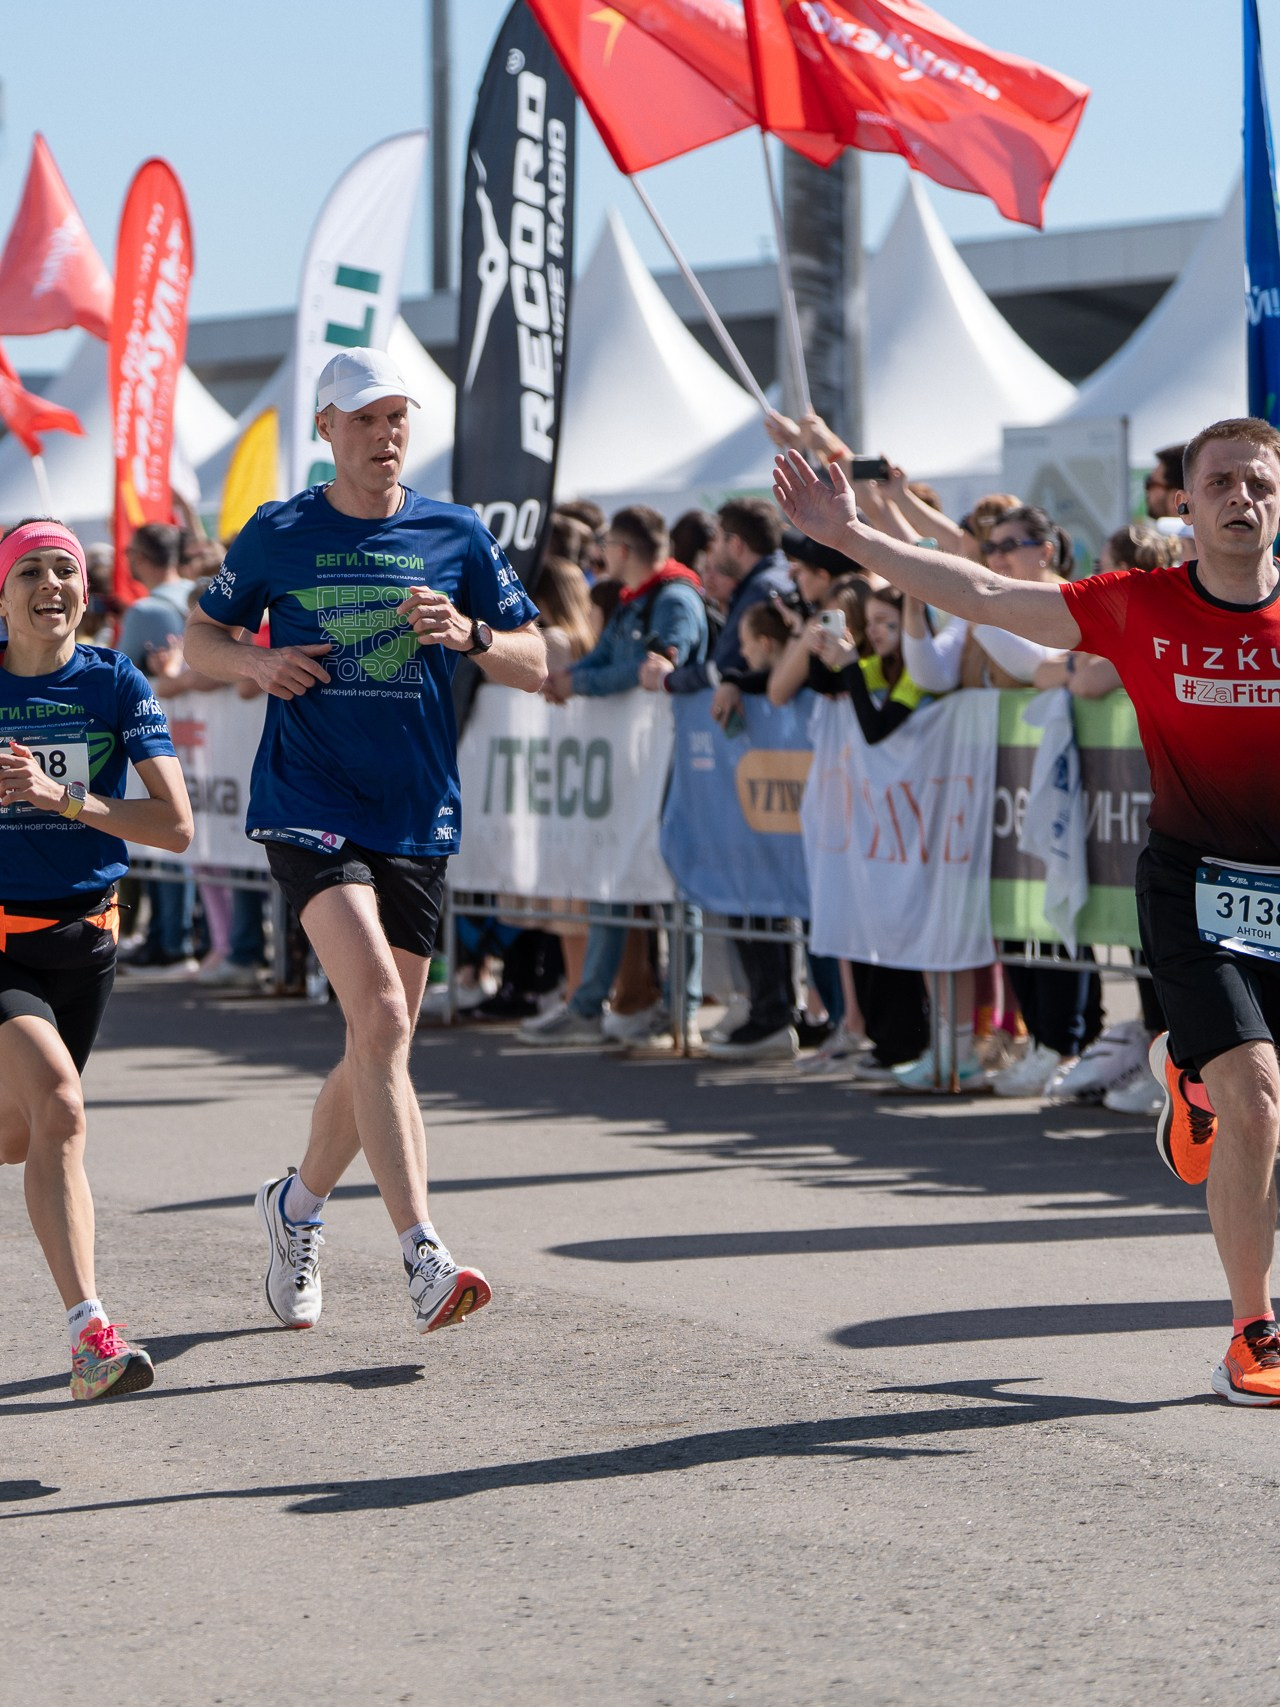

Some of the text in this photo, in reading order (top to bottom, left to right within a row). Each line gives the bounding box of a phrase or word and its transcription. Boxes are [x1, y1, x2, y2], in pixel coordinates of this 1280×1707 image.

[546, 118, 568, 258] RADIO
[509, 69, 556, 464] RECORD
[316, 553, 425, 570] БЕГИ, ГЕРОЙ!
[320, 628, 420, 660] ЭТОТ
[321, 657, 424, 685] ГОРОД
[321, 688, 357, 697] НИЖНИЙ
[358, 689, 403, 699] НОВГОРОД
[25, 822, 68, 832] НОВГОРОД
[69, 823, 86, 831] 2024
[1216, 892, 1280, 926] 313
[1237, 926, 1271, 939] АНТОН
